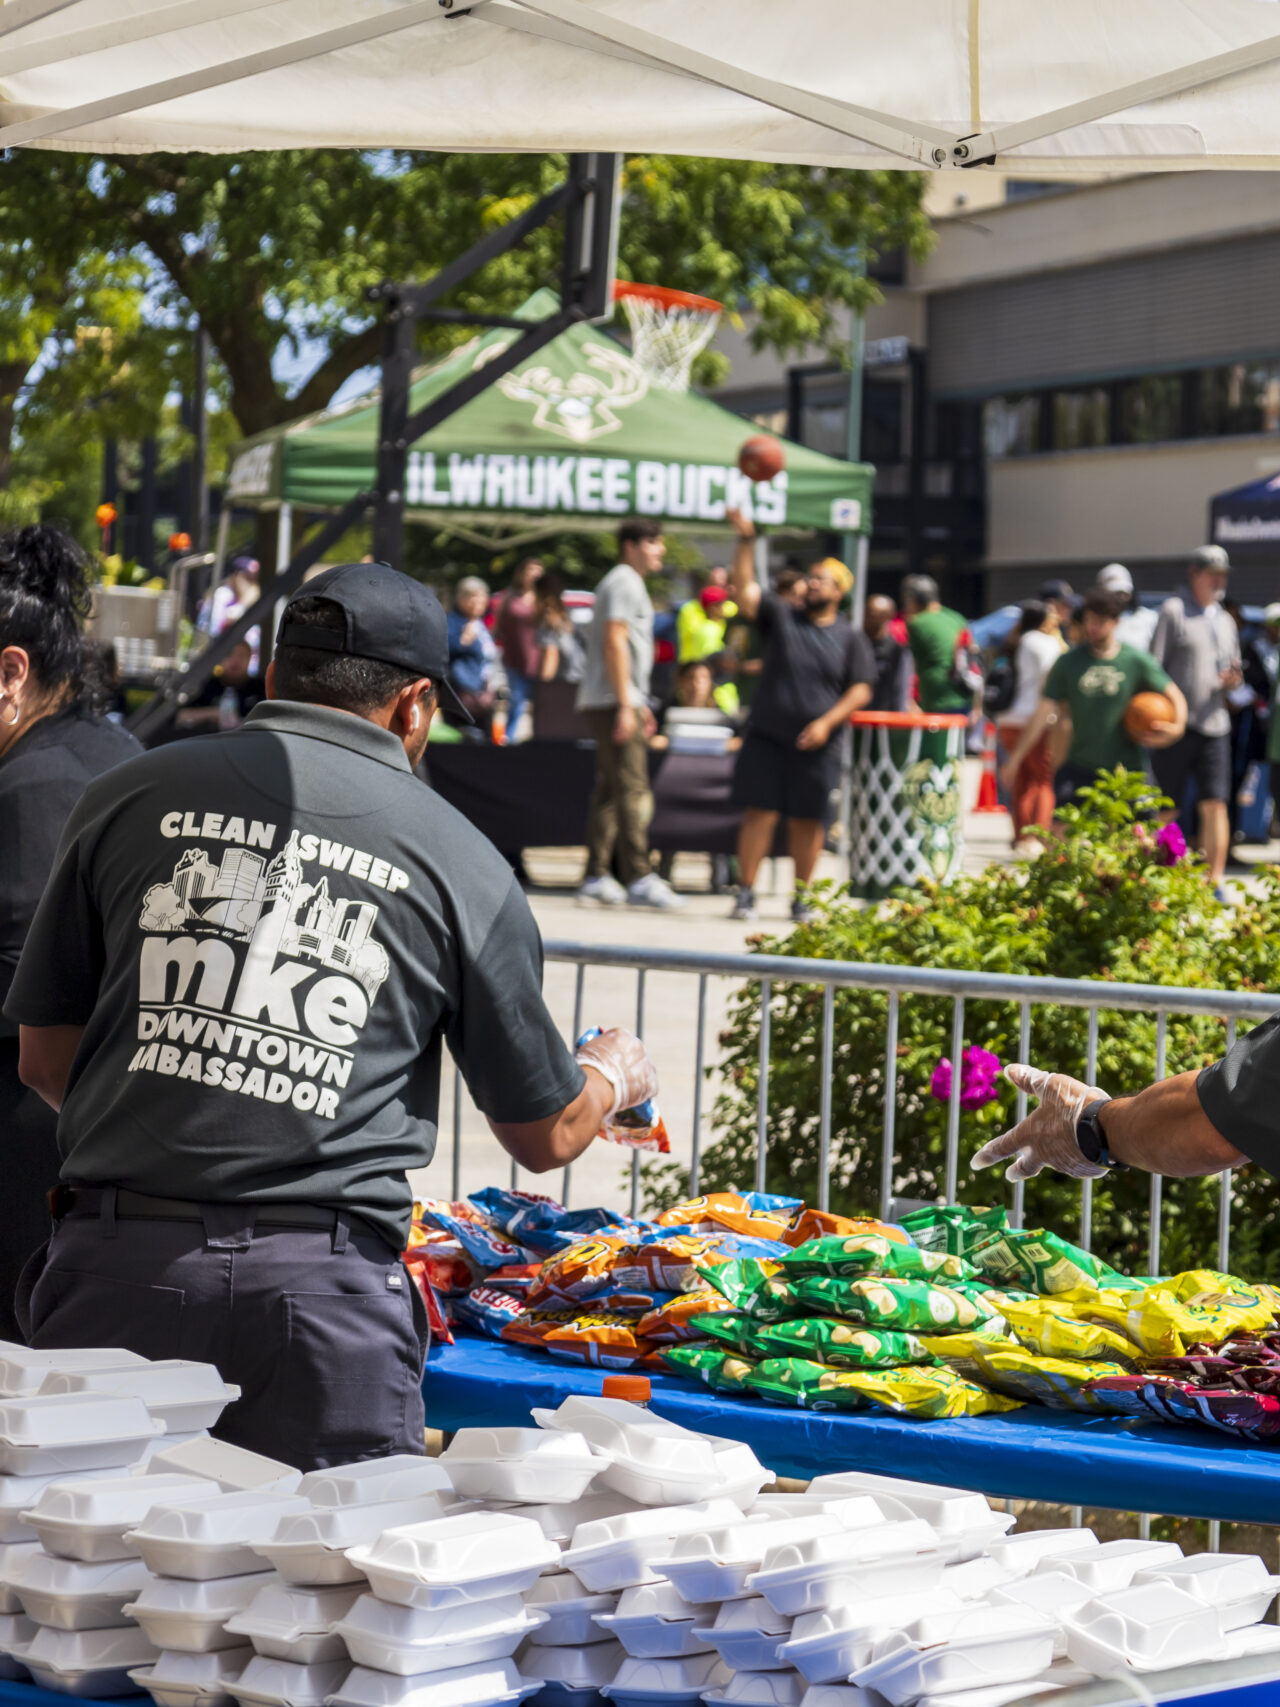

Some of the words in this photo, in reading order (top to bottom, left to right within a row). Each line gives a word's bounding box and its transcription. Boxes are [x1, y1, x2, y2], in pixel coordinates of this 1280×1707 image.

[406, 451, 630, 514] ILWAUKEE
[635, 461, 789, 524] BUCKS
[159, 811, 277, 850] CLEAN
[297, 834, 410, 894] SWEEP
[139, 915, 369, 1046] mke
[128, 1043, 340, 1120] AMBASSADOR
